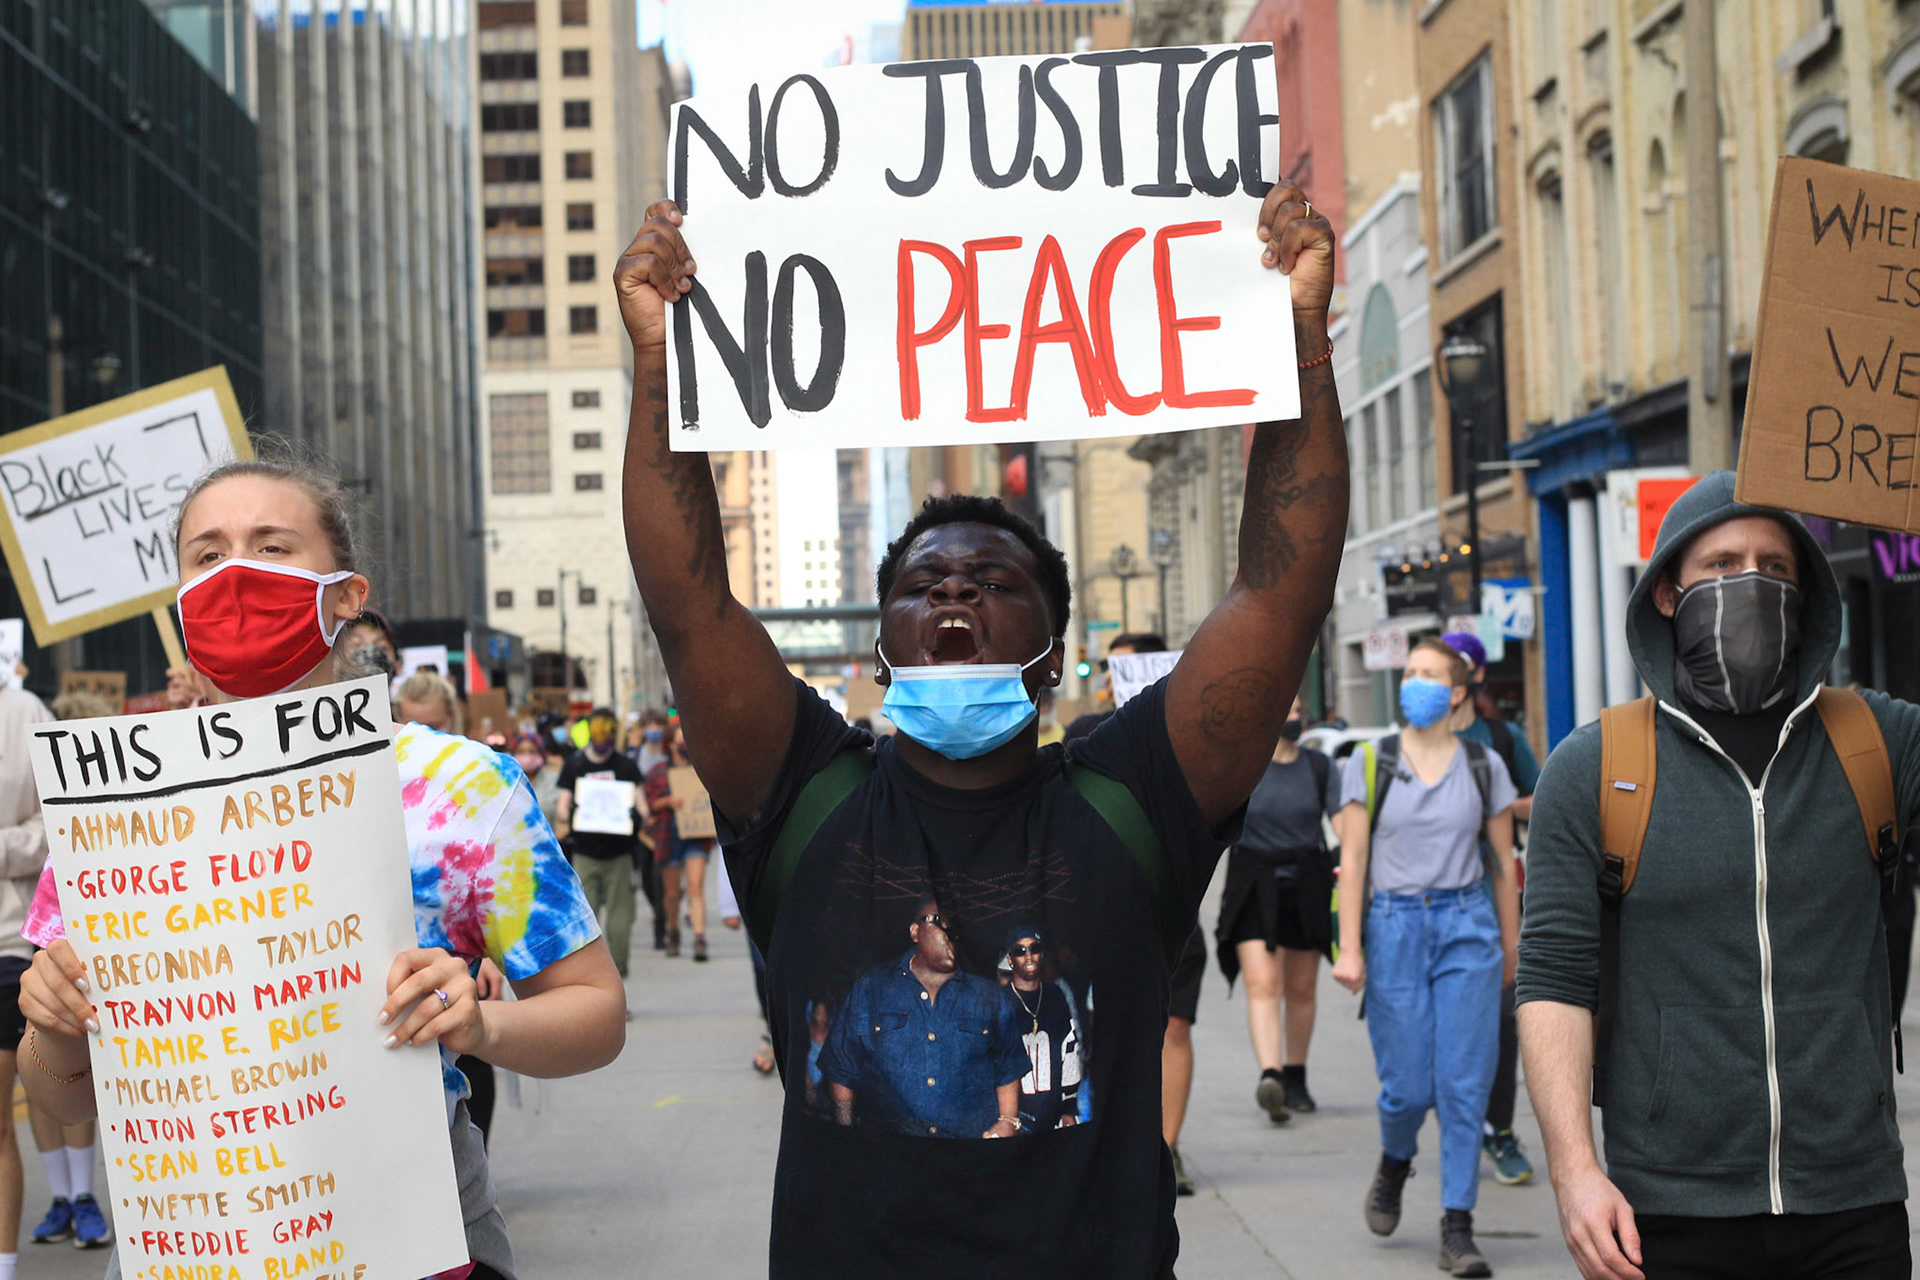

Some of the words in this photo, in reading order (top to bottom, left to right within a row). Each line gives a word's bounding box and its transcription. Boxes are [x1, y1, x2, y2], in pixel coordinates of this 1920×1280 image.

[674, 73, 840, 216] NO
[882, 44, 1279, 198] JUSTICE
[1877, 264, 1920, 308] IS
[671, 249, 846, 430] NO
[896, 219, 1260, 423] PEACE
[1825, 325, 1920, 399] WE
[73, 473, 190, 539] LIVES
[34, 724, 161, 792] THIS
[198, 712, 243, 760] IS
[275, 687, 377, 755] FOR
[72, 806, 195, 852] AHMAUD
[221, 769, 355, 834] ARBERY
[78, 861, 188, 899] GEORGE
[209, 840, 312, 887] FLOYD
[85, 911, 149, 942] ERIC
[165, 883, 314, 933] GARNER
[93, 944, 233, 992] BREONNA
[257, 914, 362, 968] TAYLOR
[104, 991, 235, 1029] TRAYVON
[254, 962, 361, 1011] MARTIN
[112, 1034, 208, 1068] TAMIR
[221, 1026, 250, 1055] E.
[269, 1002, 342, 1051] RICE
[116, 1075, 219, 1106] MICHAEL
[231, 1051, 327, 1094] BROWN
[125, 1116, 195, 1144] ALTON
[210, 1085, 346, 1138] STERLING
[129, 1150, 198, 1182] SEAN
[216, 1142, 287, 1176] BELL
[137, 1192, 228, 1220] YVETTE
[247, 1172, 335, 1213] SMITH
[142, 1229, 249, 1257] FREDDIE
[273, 1209, 333, 1244] GRAY
[149, 1264, 240, 1280] SANDRA
[264, 1240, 345, 1280] BLAND
